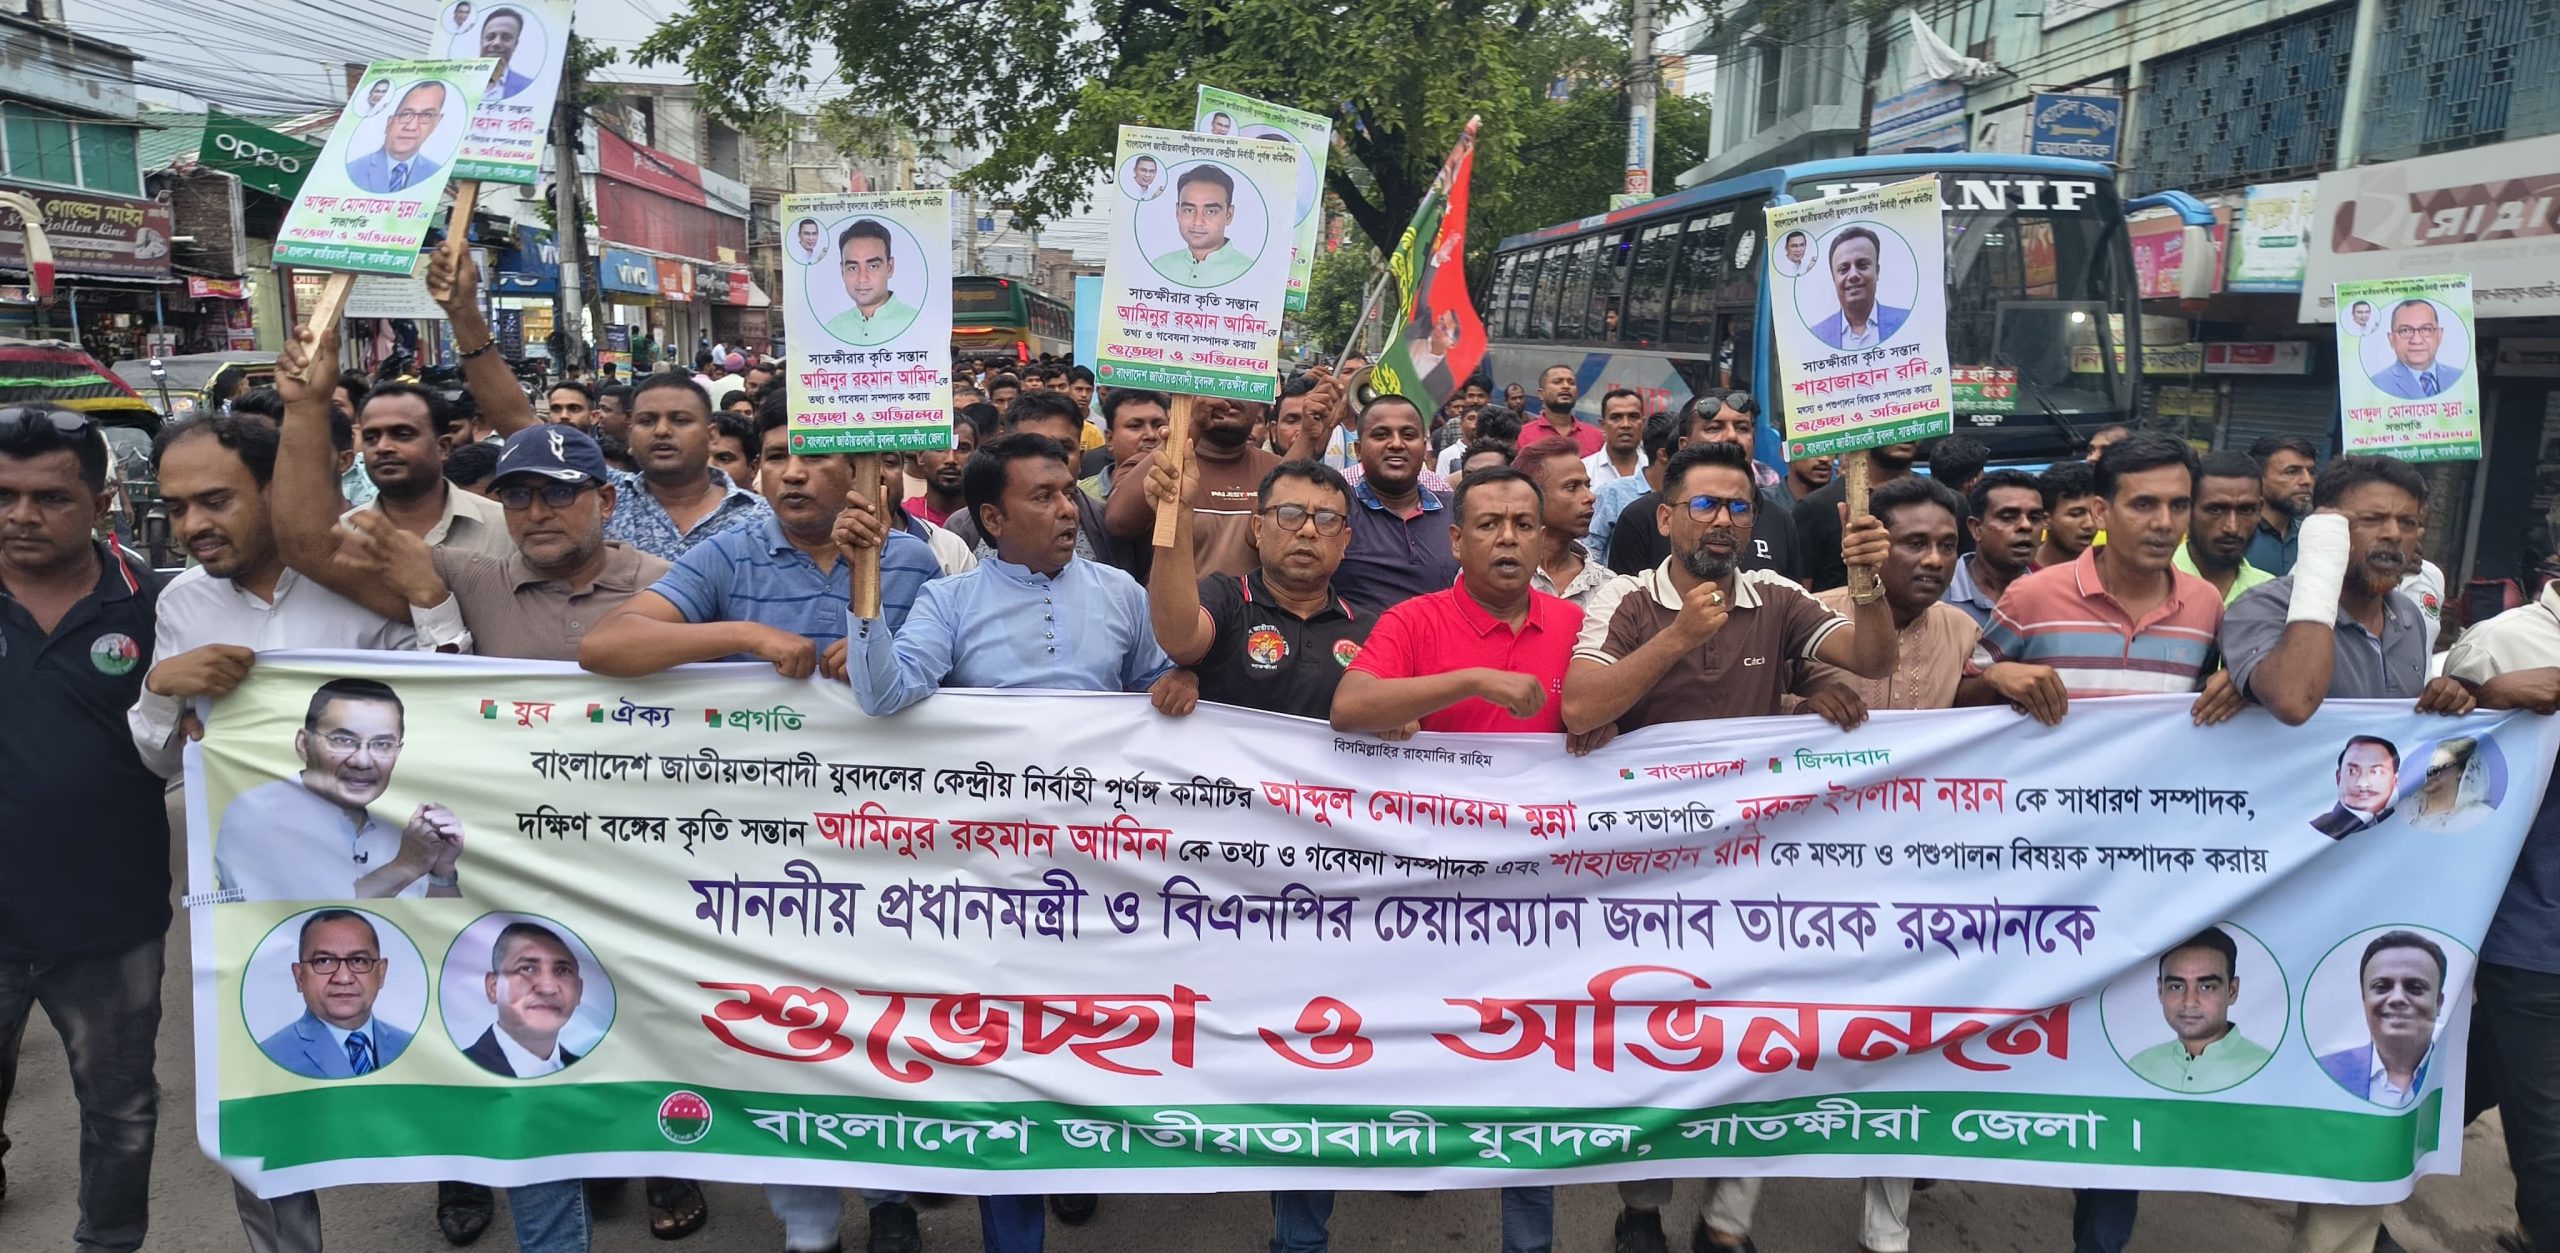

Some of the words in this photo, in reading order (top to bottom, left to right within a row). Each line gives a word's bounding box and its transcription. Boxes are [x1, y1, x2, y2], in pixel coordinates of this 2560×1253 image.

[216, 133, 301, 174] oppo
[2035, 139, 2111, 157] আবাসিক
[616, 258, 649, 287] vivo
[1129, 287, 1191, 305] সাতক্ষীরার
[1195, 292, 1222, 312] কৃতি
[1225, 295, 1259, 312] সন্তান
[1117, 303, 1170, 328] আমিনুর
[1174, 311, 1220, 330] রহমান
[1224, 313, 1267, 334] আমিন
[1123, 328, 1142, 339] তথ্য
[1145, 330, 1153, 339] ও
[1193, 336, 1230, 347] সম্পাদক
[1233, 339, 1257, 350] করায়
[808, 350, 865, 365] সাতক্ষীরার
[868, 348, 893, 368] কৃতি
[897, 350, 928, 363] সন্তান
[1107, 343, 1164, 359] শুভেচ্ছা
[1169, 350, 1185, 362] ও
[1190, 350, 1269, 373] অভিনন্দন
[1802, 353, 1859, 373] সাতক্ষীরার
[1862, 347, 1886, 367] কৃতি
[1890, 343, 1921, 358] সন্তান
[800, 368, 848, 391] আমিনুর
[852, 370, 893, 389] রহমান
[897, 364, 937, 388] আমিন
[1792, 367, 1889, 396] শাহাজাহান
[1894, 357, 1929, 379] রনি
[808, 395, 825, 405] তথ্য
[829, 395, 835, 404] ও
[871, 393, 906, 404] সম্পাদক
[908, 392, 931, 402] করায়
[2348, 407, 2383, 423] আব্দুল
[2387, 403, 2438, 419] মোনায়েম
[2441, 401, 2462, 418] মুন্না
[796, 411, 848, 426] শুভেচ্ছা
[852, 411, 866, 423] ও
[871, 406, 944, 423] অভিনন্দন
[1795, 414, 1845, 432] শুভেচ্ছা
[1850, 412, 1864, 423] ও
[1869, 398, 1941, 419] অভিনন্দন
[2385, 419, 2423, 432] সভাপতি
[512, 701, 555, 728] যুব
[611, 697, 675, 728] ঐক্য
[729, 705, 806, 732] প্রগতি
[1333, 737, 1399, 760] বিসমিল্লাহির
[1403, 745, 1456, 765] রাহমানির
[1460, 751, 1493, 768] রাহিম
[1644, 757, 1748, 781] বাংলাদেশ
[1793, 748, 1891, 771] জিন্দাবাদ
[530, 749, 652, 782] বাংলাদেশ
[659, 747, 821, 788] জাতীয়তাবাদী
[828, 762, 926, 796] যুবদলের
[934, 760, 1015, 800] কেন্দ্রীয়
[1022, 765, 1097, 805] নির্বাহী
[1168, 775, 1254, 808] কমিটির
[1260, 780, 1358, 828] আব্দুল
[1368, 790, 1508, 829] মোনায়েম
[1518, 800, 1577, 840] মুন্না
[1588, 810, 1617, 833] কে
[1624, 801, 1715, 834] সভাপতি
[1935, 778, 2007, 814] নয়ন
[2016, 788, 2049, 813] কে
[2055, 785, 2142, 815] সাধারণ
[2149, 787, 2255, 821] সম্পাদক,
[516, 804, 591, 841] দক্ষিণ
[599, 815, 670, 843] বঙ্গের
[676, 809, 733, 856] কৃতি
[739, 817, 808, 846] সন্তান
[813, 801, 940, 859] আমিনুর
[948, 818, 1059, 859] রহমান
[1068, 813, 1174, 862] আমিন
[1179, 839, 1212, 863] কে
[1218, 840, 1270, 868] তথ্য
[1277, 845, 1295, 867] ও
[1305, 843, 1387, 877] গবেষনা
[1393, 854, 1489, 880] সম্পাদক
[1495, 859, 1539, 877] এবং
[1549, 845, 1708, 881] শাহাজাহান
[1771, 842, 1802, 868] কে
[1807, 842, 1867, 869] মৎস্য
[1875, 845, 1894, 867] ও
[1903, 841, 2004, 871] পশুপালন
[2009, 837, 2089, 872] বিষয়ক
[2095, 843, 2197, 873] সম্পাদক
[2202, 846, 2269, 874] করায়
[690, 861, 866, 938] মাননীয়
[878, 868, 1088, 941] প্রধানমন্ত্রী
[1104, 891, 1141, 934] ও
[1158, 874, 1360, 942] বিএনপির
[1375, 894, 1588, 949] চেয়ারম্যান
[1598, 896, 1720, 952] জনাব
[1731, 893, 1880, 952] তারেক
[1891, 897, 2100, 960] রহমানকে
[695, 981, 1213, 1085] শুভেচ্ছা
[1257, 994, 1374, 1071] ও
[1430, 964, 2090, 1075] অভিনন্দন
[743, 1105, 1038, 1155] বাংলাদেশ
[1054, 1109, 1448, 1158] জাতীয়তাবাদী
[1461, 1120, 1653, 1166] যুবদল,
[1678, 1096, 1931, 1148] সাতক্ষীরা
